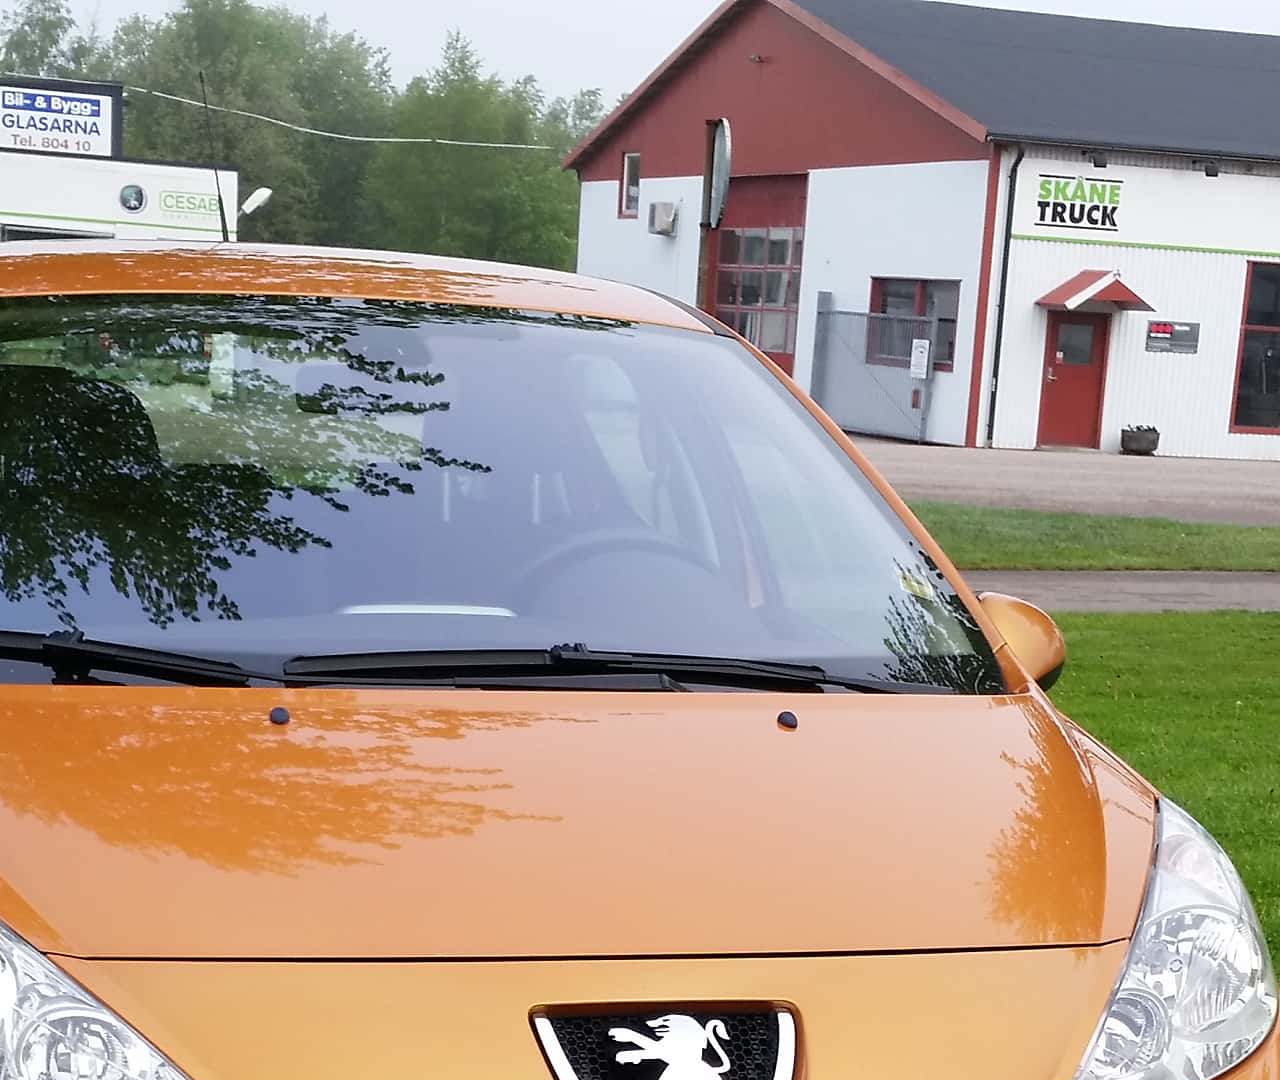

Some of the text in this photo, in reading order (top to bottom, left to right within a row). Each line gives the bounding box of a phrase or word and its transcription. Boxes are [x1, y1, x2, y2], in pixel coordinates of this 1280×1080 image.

[4, 92, 99, 116] Bil- & Bygg-
[2, 113, 100, 136] GLASARNA
[11, 134, 91, 151] Tel. 804 10
[1038, 175, 1120, 204] SKÅNE
[162, 194, 220, 212] CESAB
[1037, 200, 1118, 227] TRUCK
